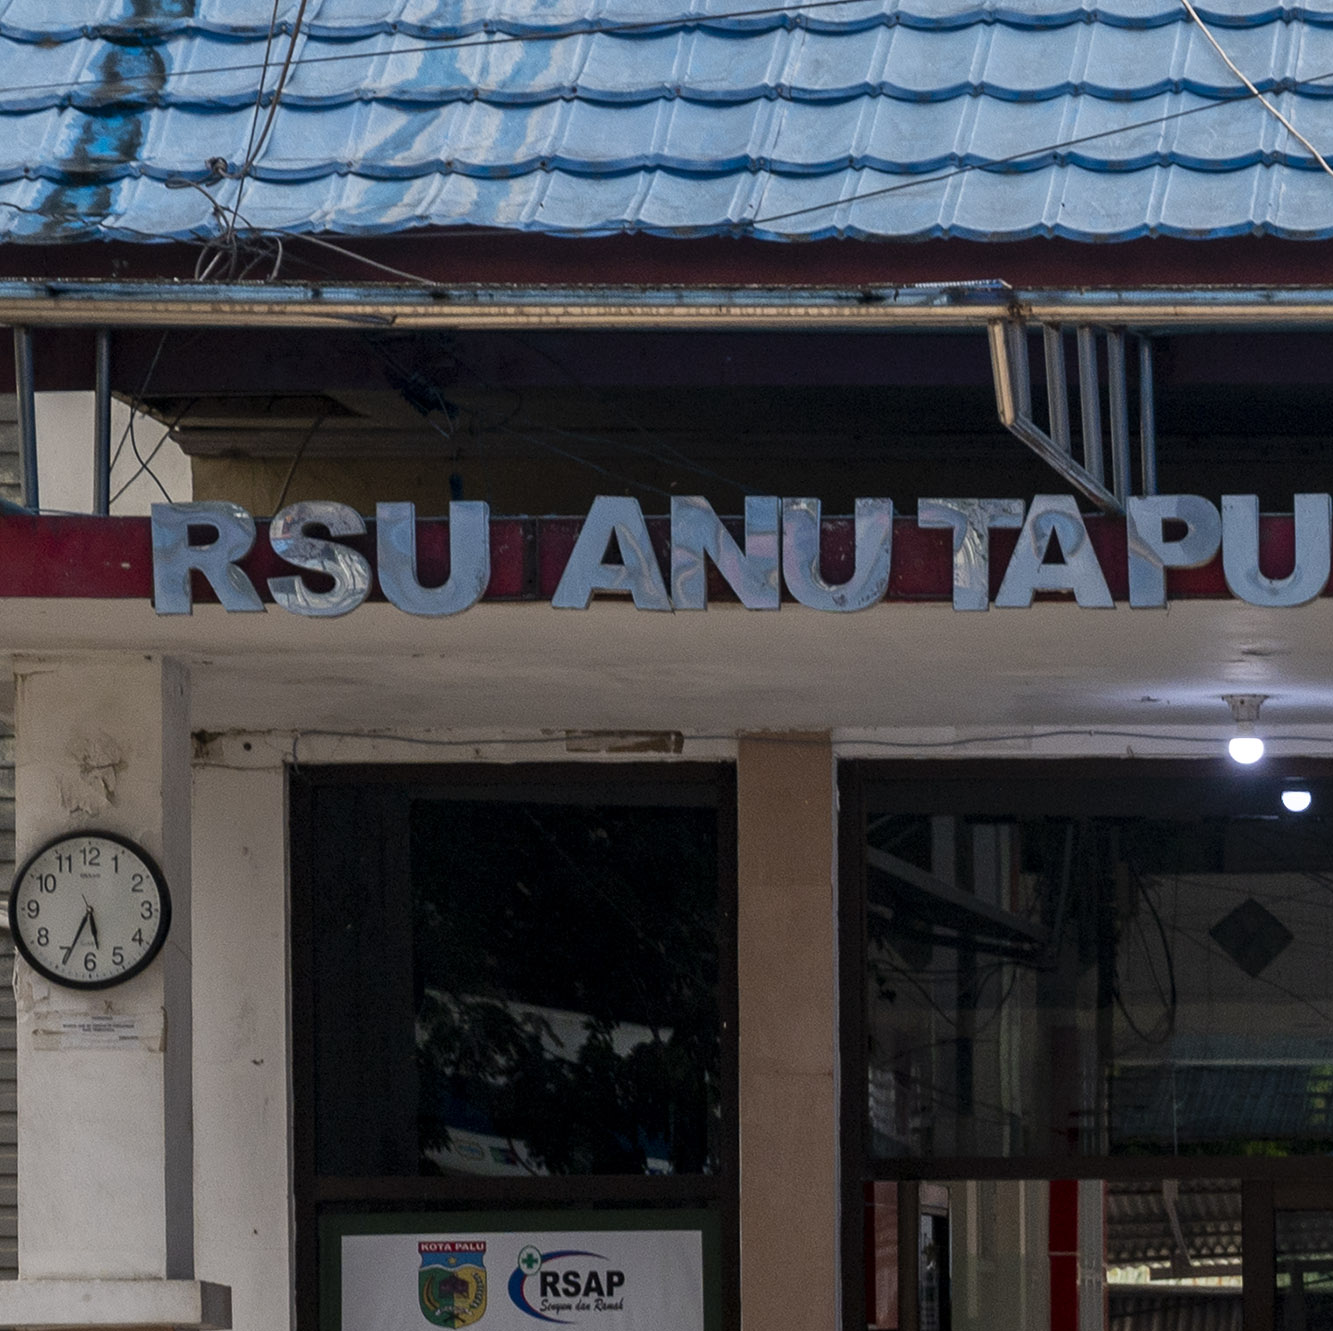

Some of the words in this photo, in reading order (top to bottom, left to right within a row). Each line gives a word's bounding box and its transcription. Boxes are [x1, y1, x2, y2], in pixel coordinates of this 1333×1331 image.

[151, 500, 491, 617] RSU
[56, 855, 72, 872] 11
[81, 847, 100, 866] 12
[112, 855, 118, 873] 1
[37, 874, 56, 893] 10
[132, 874, 143, 892] 2
[27, 901, 39, 919] 9
[141, 901, 153, 920] 3
[37, 927, 49, 946] 8
[132, 928, 143, 946] 4
[84, 953, 96, 971] 6
[113, 947, 123, 965] 5
[420, 1243, 452, 1251] KOTA
[455, 1243, 484, 1251] PALU
[539, 1271, 625, 1297] RSAP
